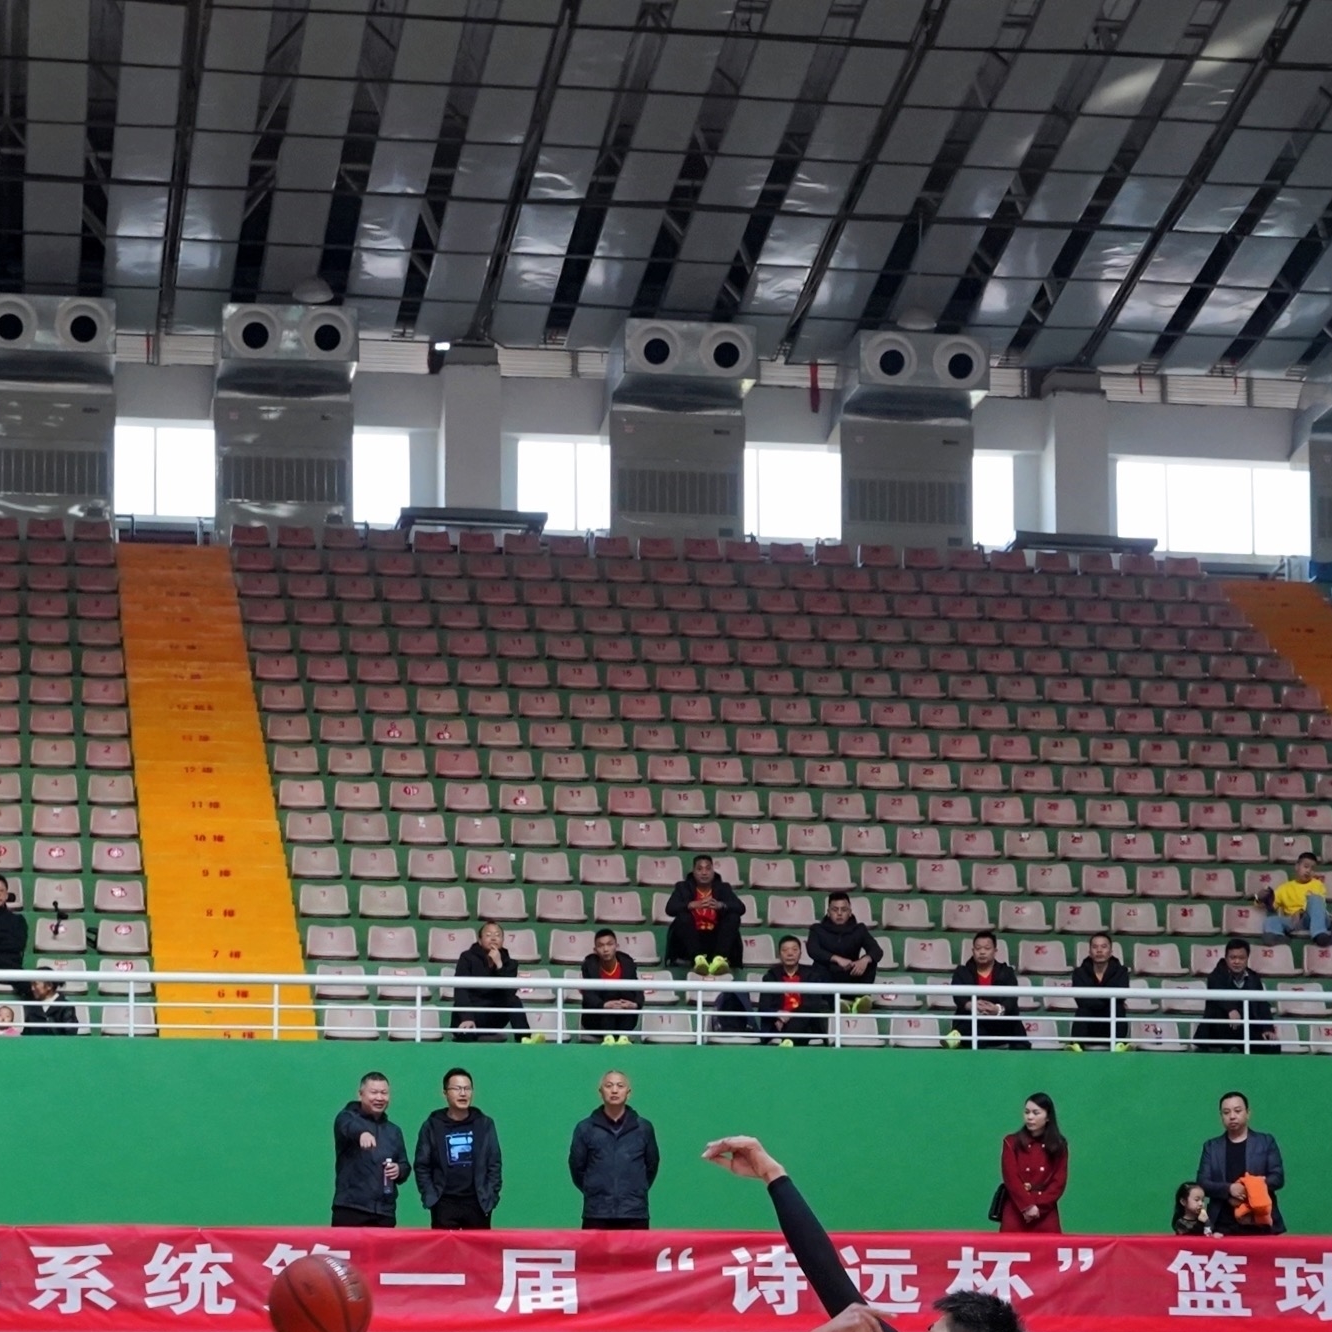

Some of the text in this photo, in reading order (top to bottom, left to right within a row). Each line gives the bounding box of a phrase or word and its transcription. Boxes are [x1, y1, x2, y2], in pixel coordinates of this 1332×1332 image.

[104, 745, 111, 753] 2
[453, 753, 460, 761] 7
[818, 764, 830, 772] 21
[623, 790, 635, 798] 13
[730, 794, 742, 802] 17
[898, 903, 910, 911] 21
[920, 943, 933, 951] 21
